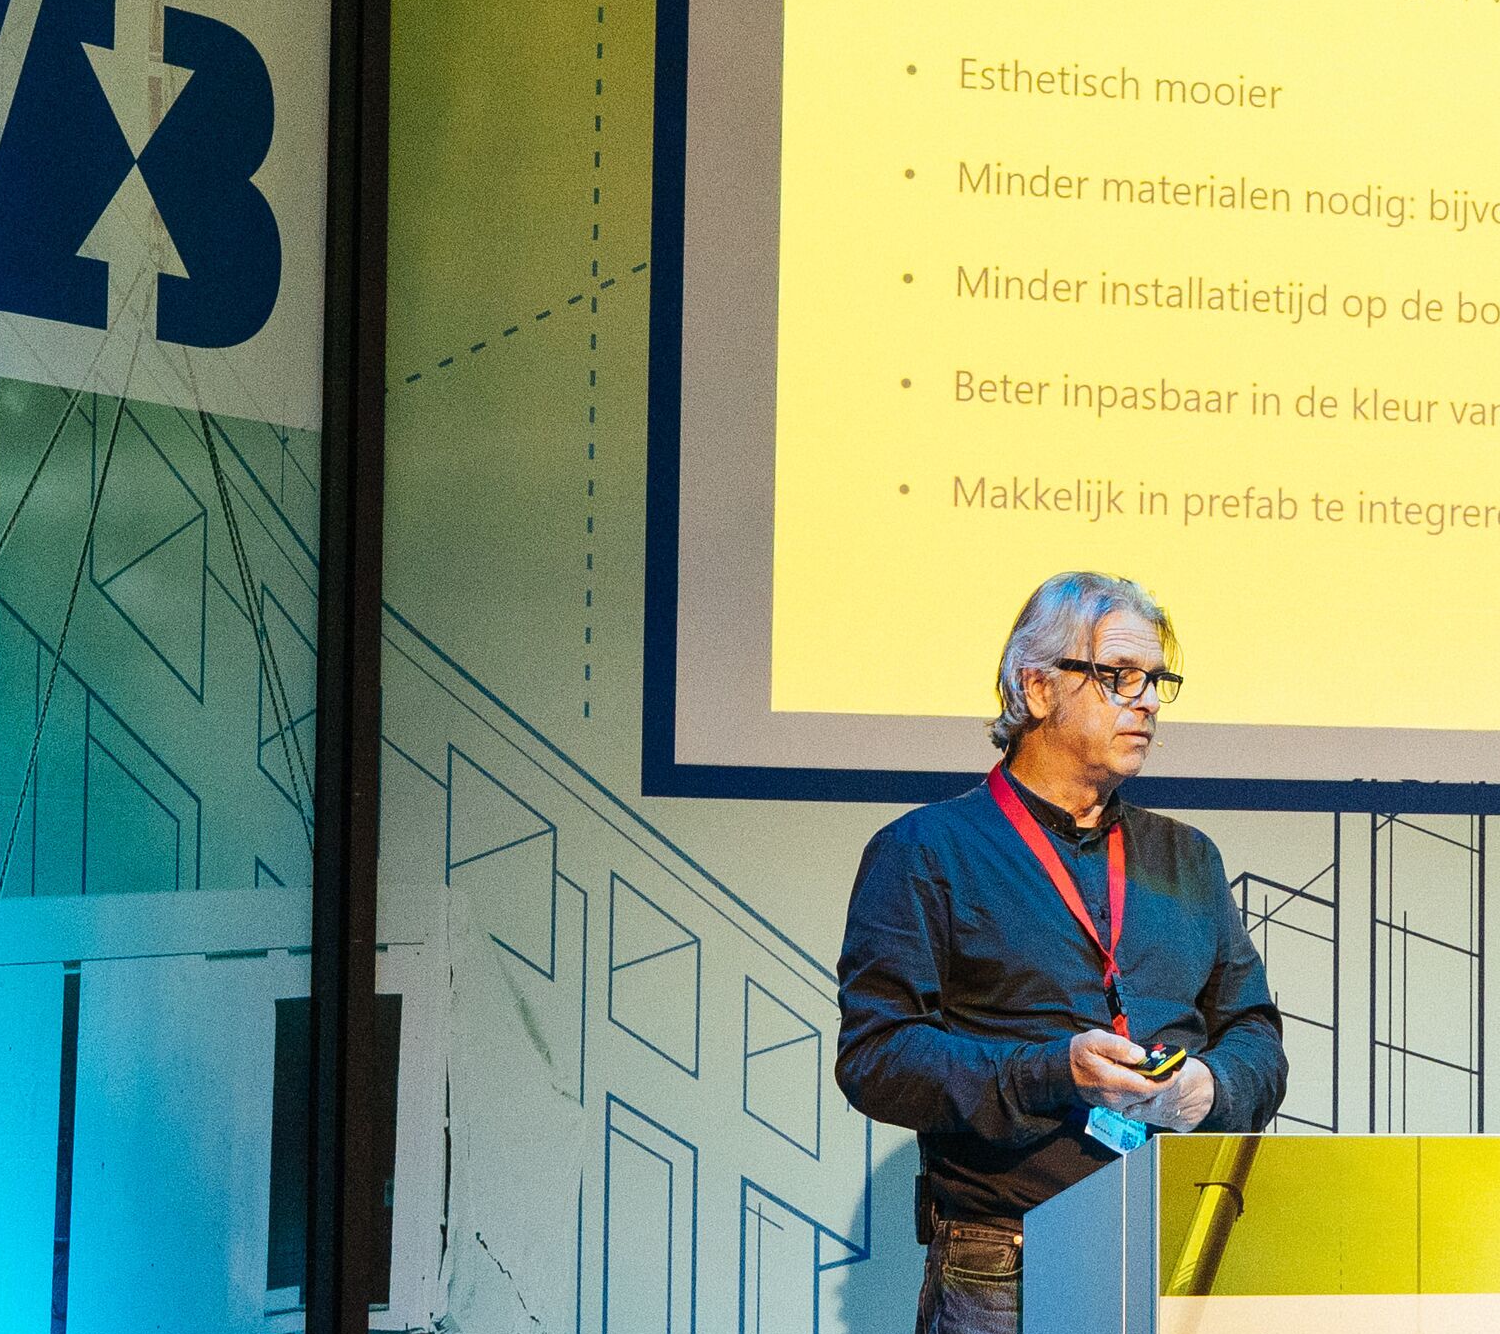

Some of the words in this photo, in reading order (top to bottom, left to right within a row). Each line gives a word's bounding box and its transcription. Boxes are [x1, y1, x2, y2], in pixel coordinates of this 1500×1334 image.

[960, 57, 1140, 101] Esthetisch
[1155, 74, 1284, 109] mooier
[959, 161, 1090, 199] Minder
[1103, 174, 1290, 213] materialen
[1306, 184, 1415, 228] nodig:
[957, 265, 1088, 304] Minder
[1101, 271, 1327, 324] installatietijd
[1342, 295, 1387, 328] op
[1401, 289, 1443, 322] de
[955, 370, 1051, 406] Beter
[1063, 373, 1239, 419] inpasbaar
[1252, 382, 1280, 416] in
[1295, 385, 1338, 419] de
[1353, 387, 1439, 423] kleur
[953, 476, 1124, 523] Makkelijk
[1139, 481, 1168, 515] in
[1184, 486, 1298, 526] prefab
[1311, 492, 1344, 522] te
